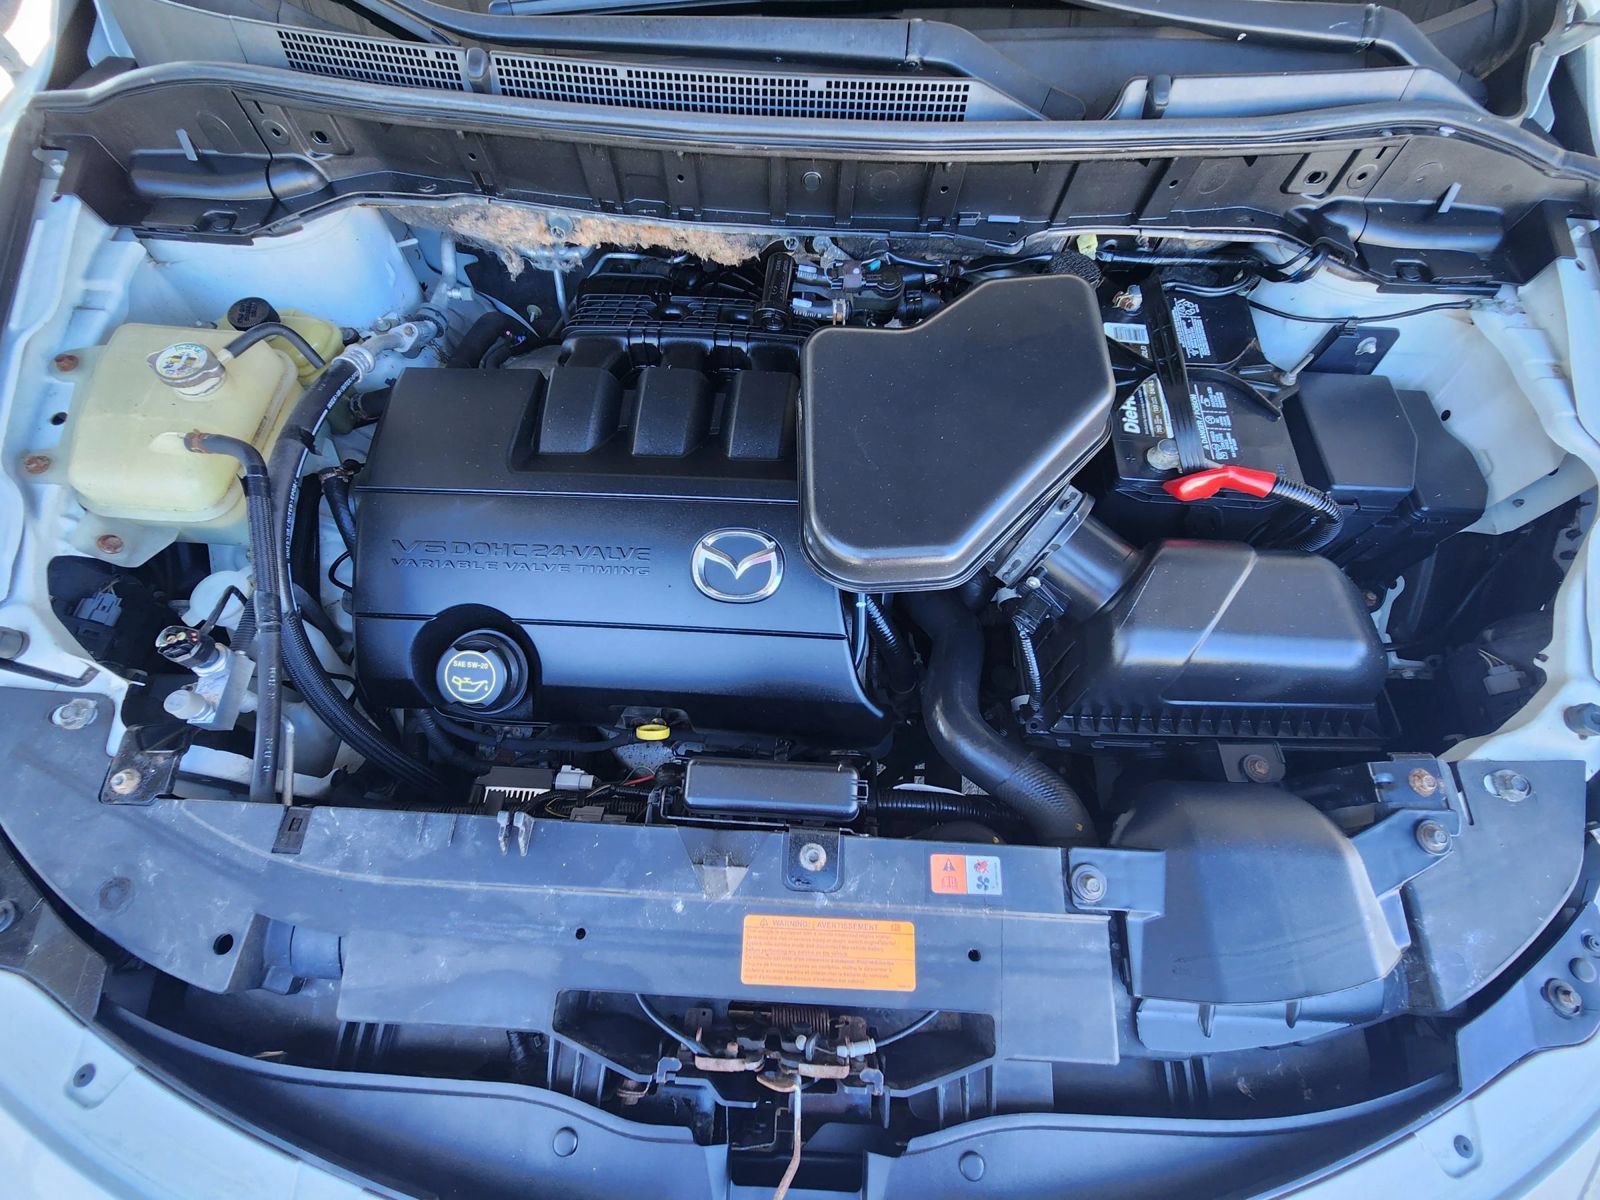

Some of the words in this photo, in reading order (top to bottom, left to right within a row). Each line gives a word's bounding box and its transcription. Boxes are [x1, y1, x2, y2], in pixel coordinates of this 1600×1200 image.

[1197, 420, 1208, 444] DANGER
[392, 539, 447, 554] V6
[451, 541, 528, 556] DOHC
[531, 544, 652, 560] 24-VALVE
[391, 558, 498, 570] VARIABLE
[503, 561, 570, 573] VALVE
[576, 564, 650, 576] TIMING
[453, 660, 466, 668] SAE
[466, 661, 489, 669] 5W-20
